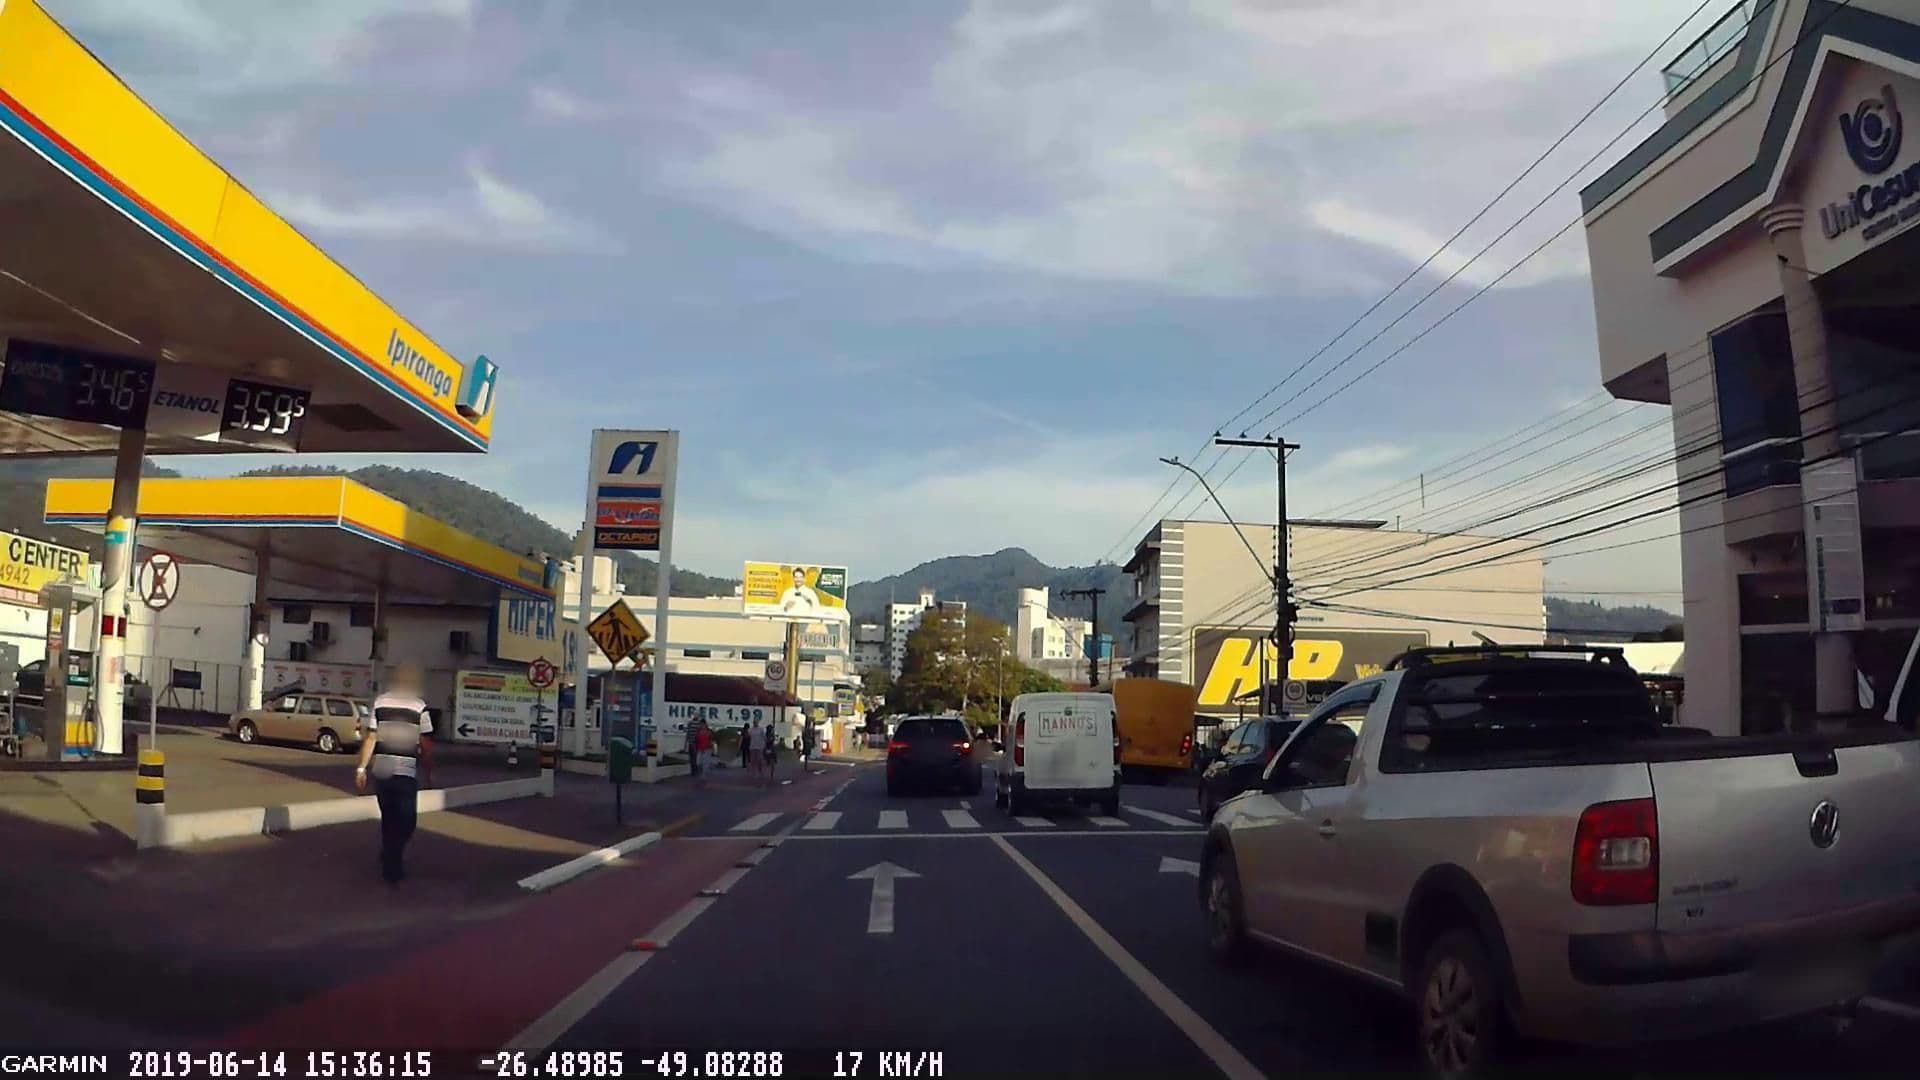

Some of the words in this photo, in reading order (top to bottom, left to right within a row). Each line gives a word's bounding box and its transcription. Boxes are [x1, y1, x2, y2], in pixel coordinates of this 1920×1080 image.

[387, 327, 453, 397] Ipiranga
[154, 391, 220, 415] ETANOL
[9, 537, 81, 577] CENTER
[668, 705, 719, 720] HIPER
